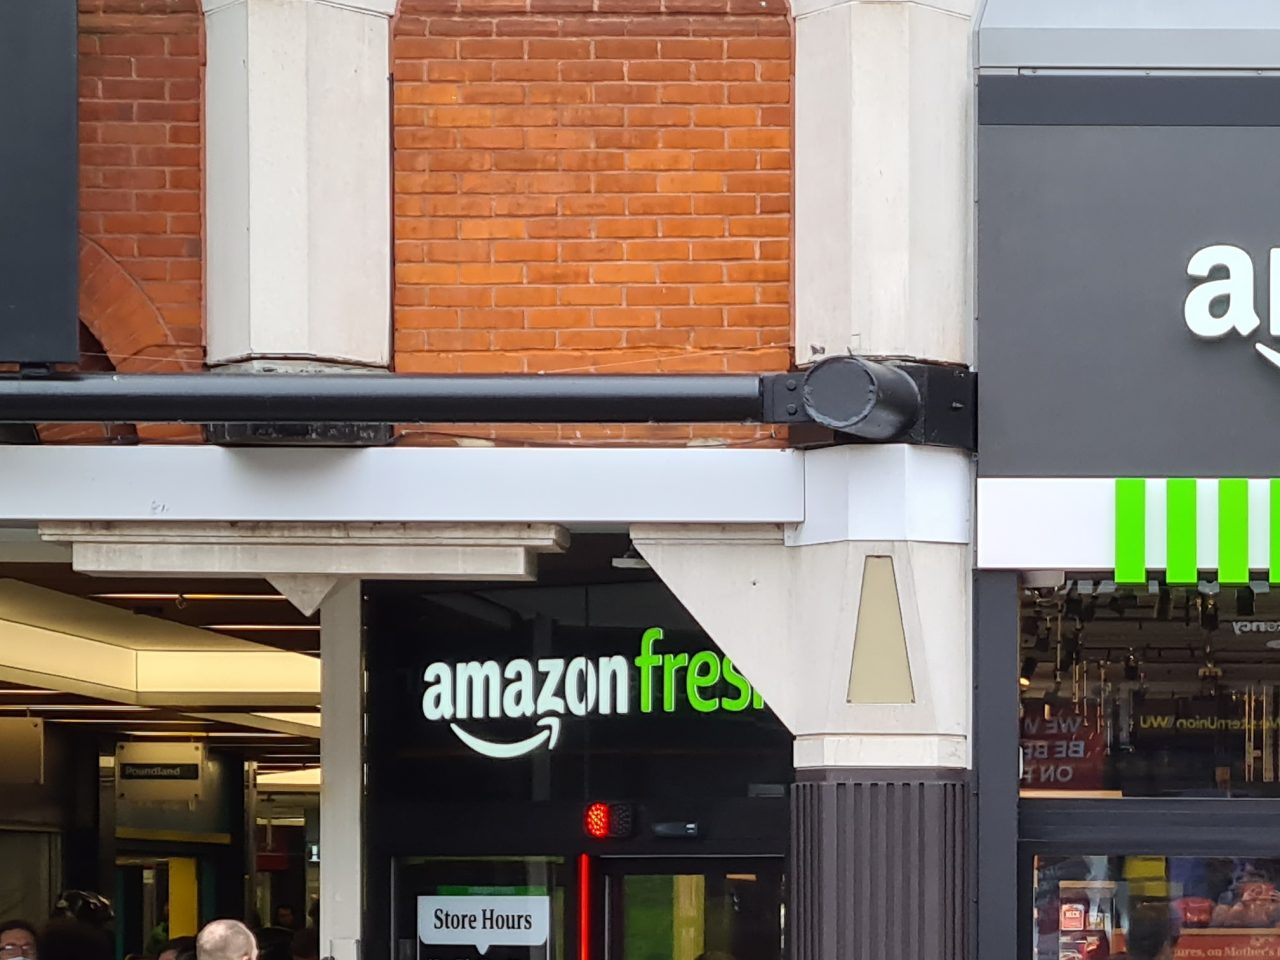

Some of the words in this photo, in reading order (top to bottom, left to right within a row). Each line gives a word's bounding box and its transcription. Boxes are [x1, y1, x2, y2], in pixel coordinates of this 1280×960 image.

[422, 655, 629, 721] amazon
[635, 627, 764, 713] fres
[434, 908, 477, 930] Store
[481, 908, 532, 930] Hours
[1207, 949, 1222, 957] on
[1223, 947, 1275, 957] Mother's
